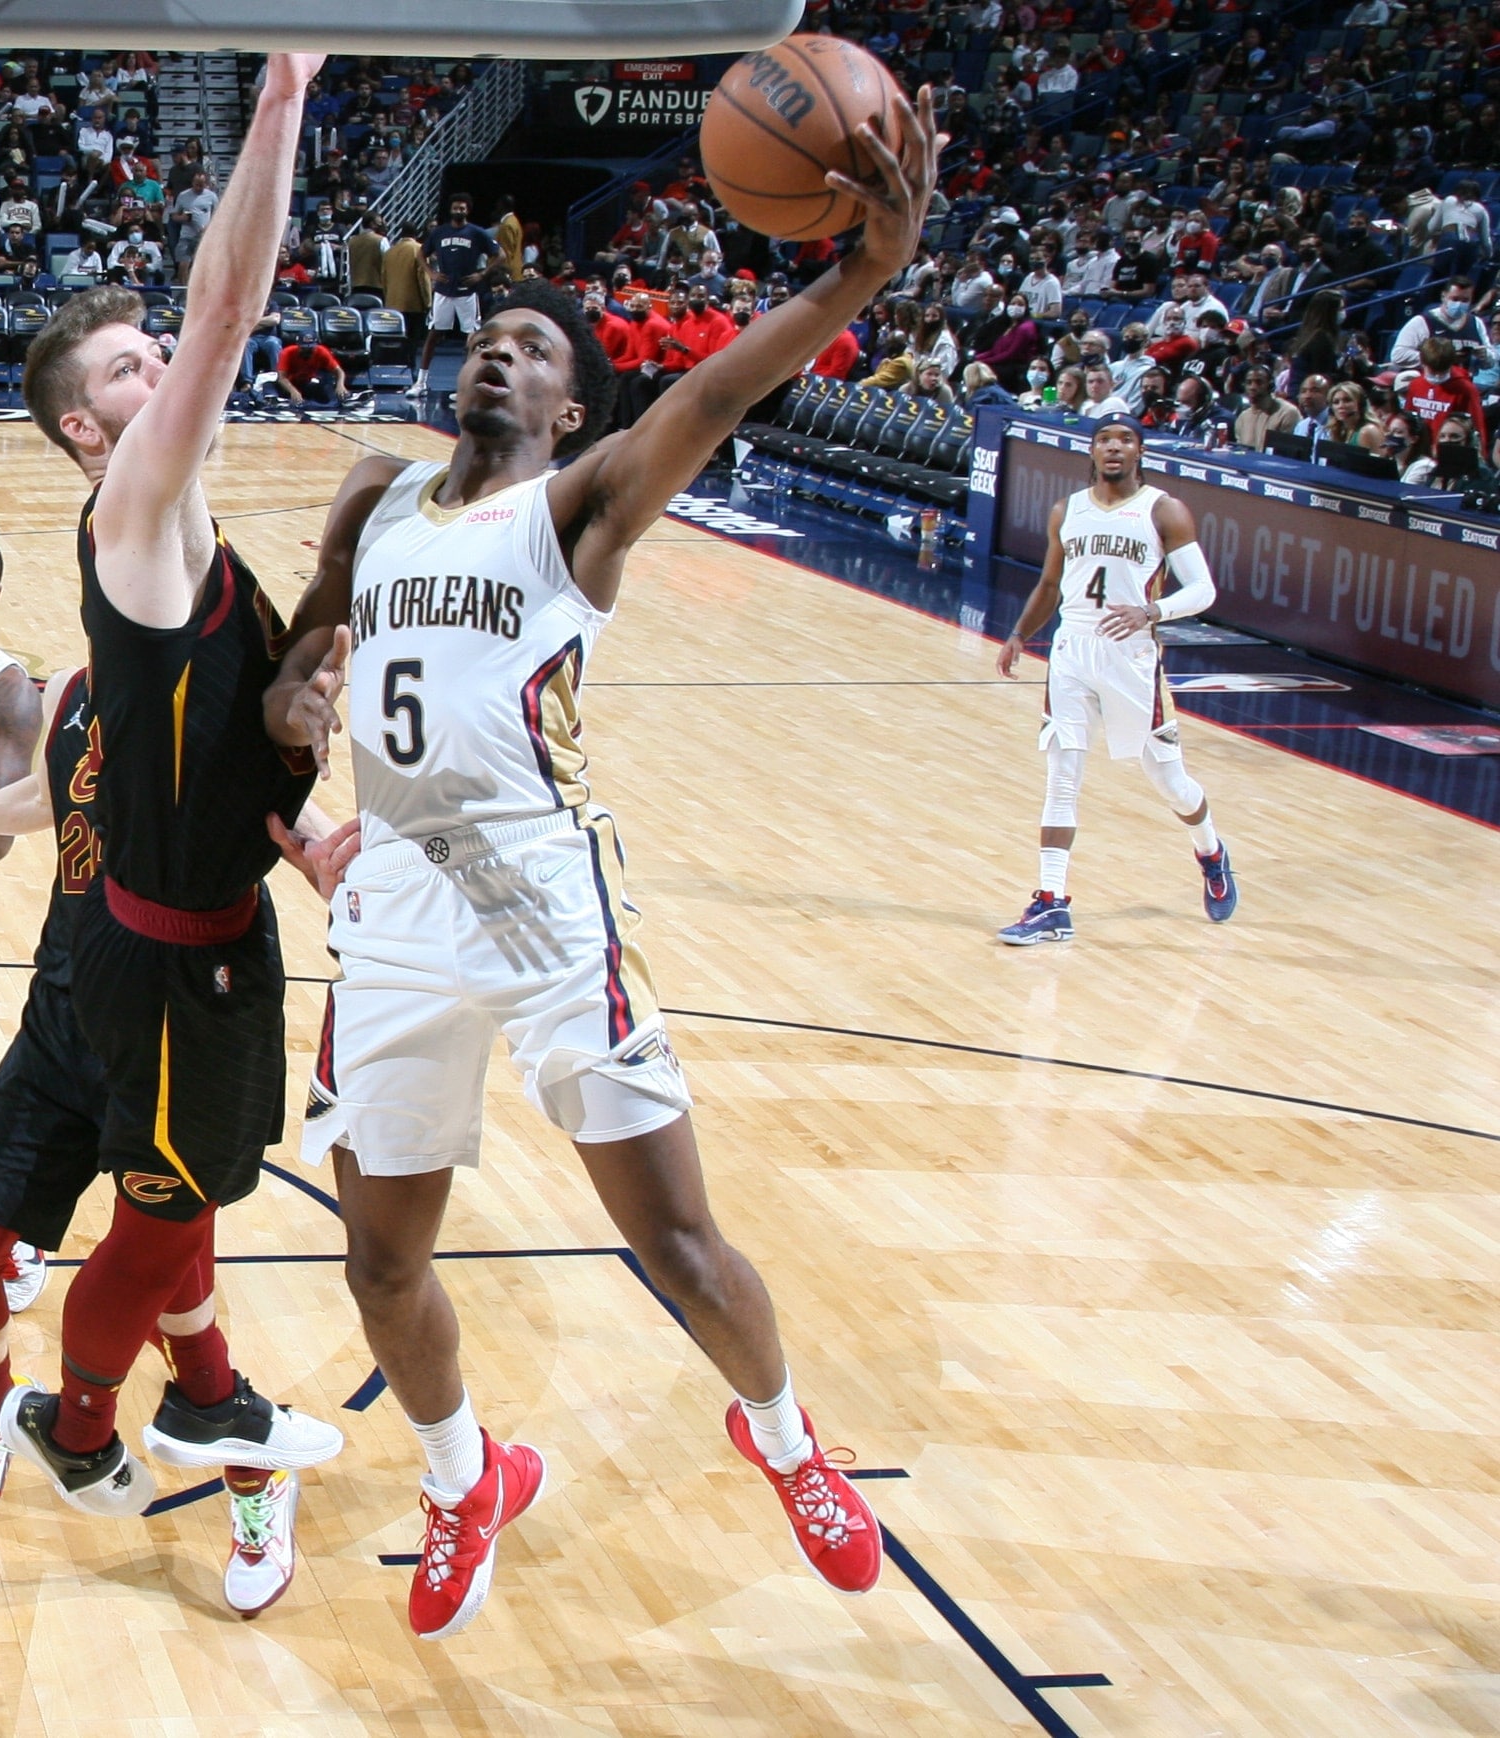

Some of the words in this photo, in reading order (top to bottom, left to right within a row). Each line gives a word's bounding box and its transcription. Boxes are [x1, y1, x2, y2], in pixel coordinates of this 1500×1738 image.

[624, 63, 683, 72] EMERGENCY
[618, 90, 712, 109] FANDUE
[618, 112, 703, 124] SPORTSB
[973, 446, 999, 472] SEAT
[970, 469, 997, 497] GEEK
[1310, 494, 1341, 513] SEATGEEK
[1358, 505, 1390, 525] SEATGEEK
[465, 508, 514, 524] ibotta
[1408, 517, 1443, 537] SEATGEEK
[1091, 534, 1148, 565] ORLEANS
[1461, 528, 1499, 549] SEATGEEK
[1085, 566, 1107, 609] 4
[1251, 524, 1321, 614] GET
[1330, 537, 1477, 660] PULLED
[351, 582, 382, 652] EW
[388, 575, 525, 642] ORLEANS
[382, 657, 427, 769] 5
[60, 811, 102, 894] 2
